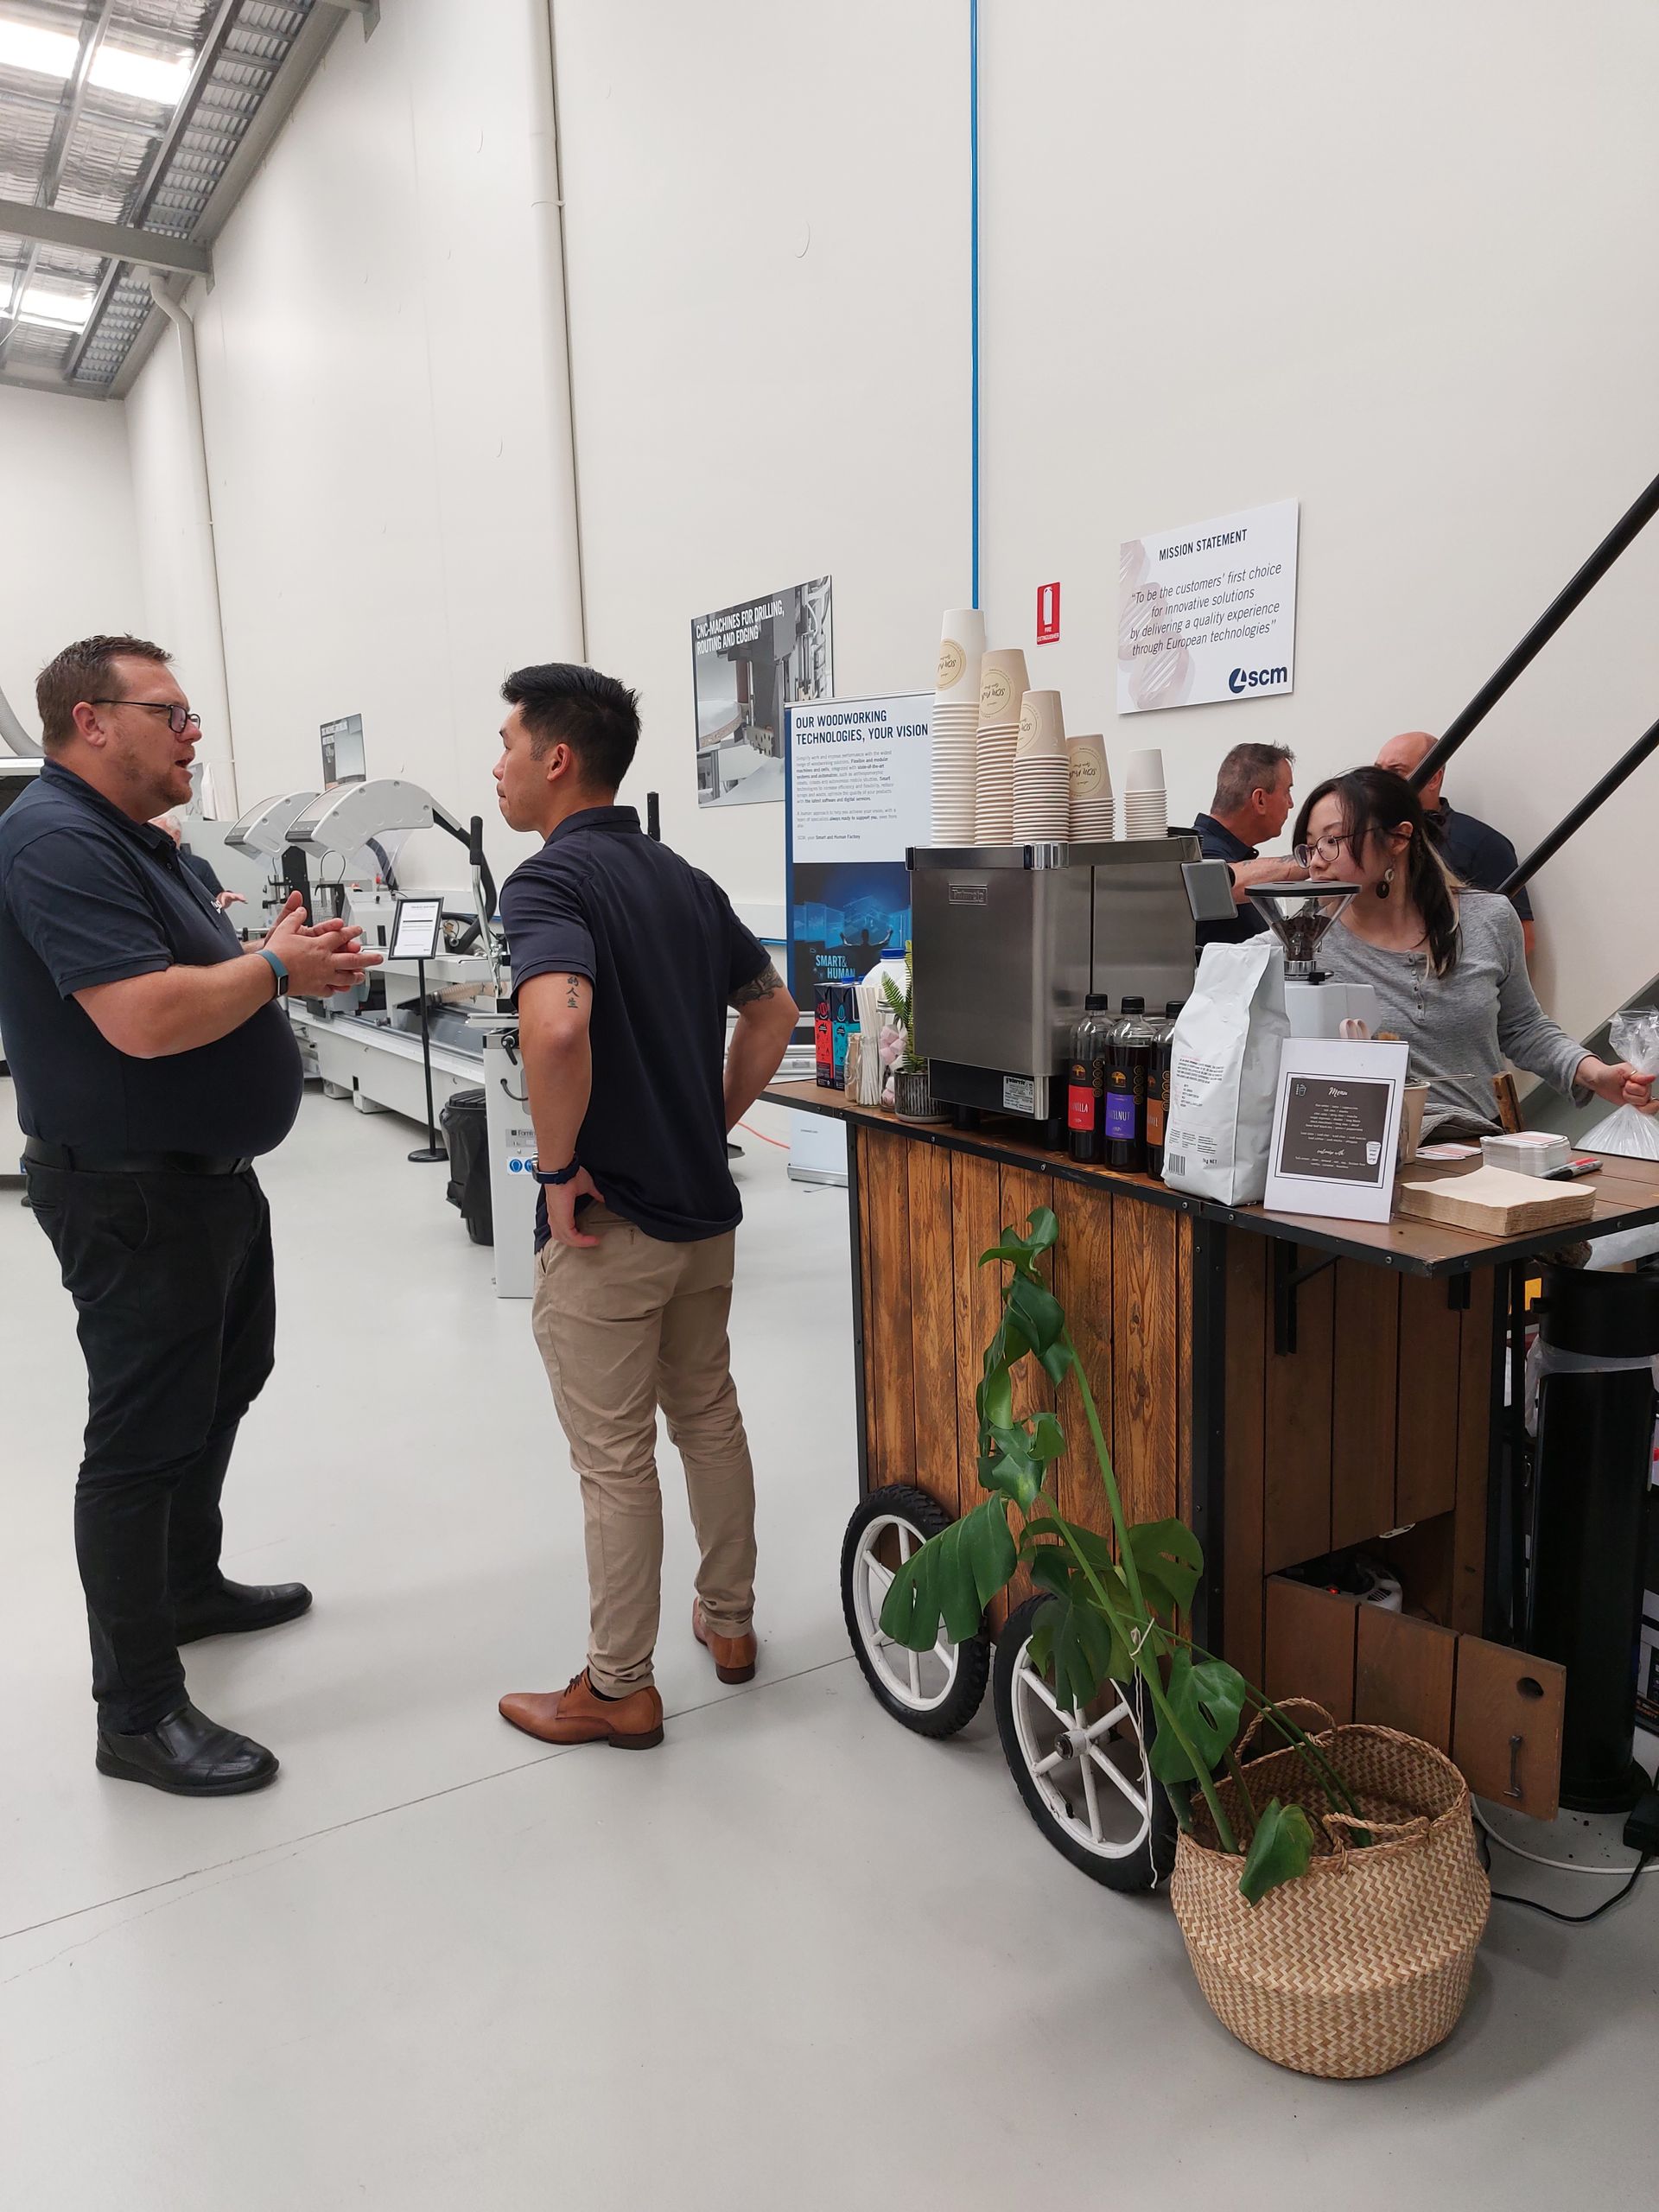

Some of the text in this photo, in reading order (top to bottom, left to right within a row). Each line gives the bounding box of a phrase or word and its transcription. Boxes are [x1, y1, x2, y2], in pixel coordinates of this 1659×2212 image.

[1159, 529, 1248, 561] MISSION STATEMENT
[1147, 589, 1157, 601] be
[1160, 585, 1173, 599] the
[1227, 568, 1246, 585] first
[1249, 563, 1281, 580] choice
[1151, 588, 1255, 618] for innovative solutions
[696, 600, 785, 639] CNC-MACHINES FOR DRILLING,
[1130, 602, 1280, 641] by delivering a quality experience
[696, 625, 759, 655] ROUTING AND EDGING
[1132, 639, 1164, 657] through
[1166, 632, 1208, 650] European
[1248, 666, 1287, 687] scm
[796, 709, 887, 728] OUR WOODWORKING
[796, 723, 928, 745] TECHNOLOGIES, YOUR VISION
[827, 967, 855, 979] HUMAN
[1328, 1086, 1348, 1097] Menu
